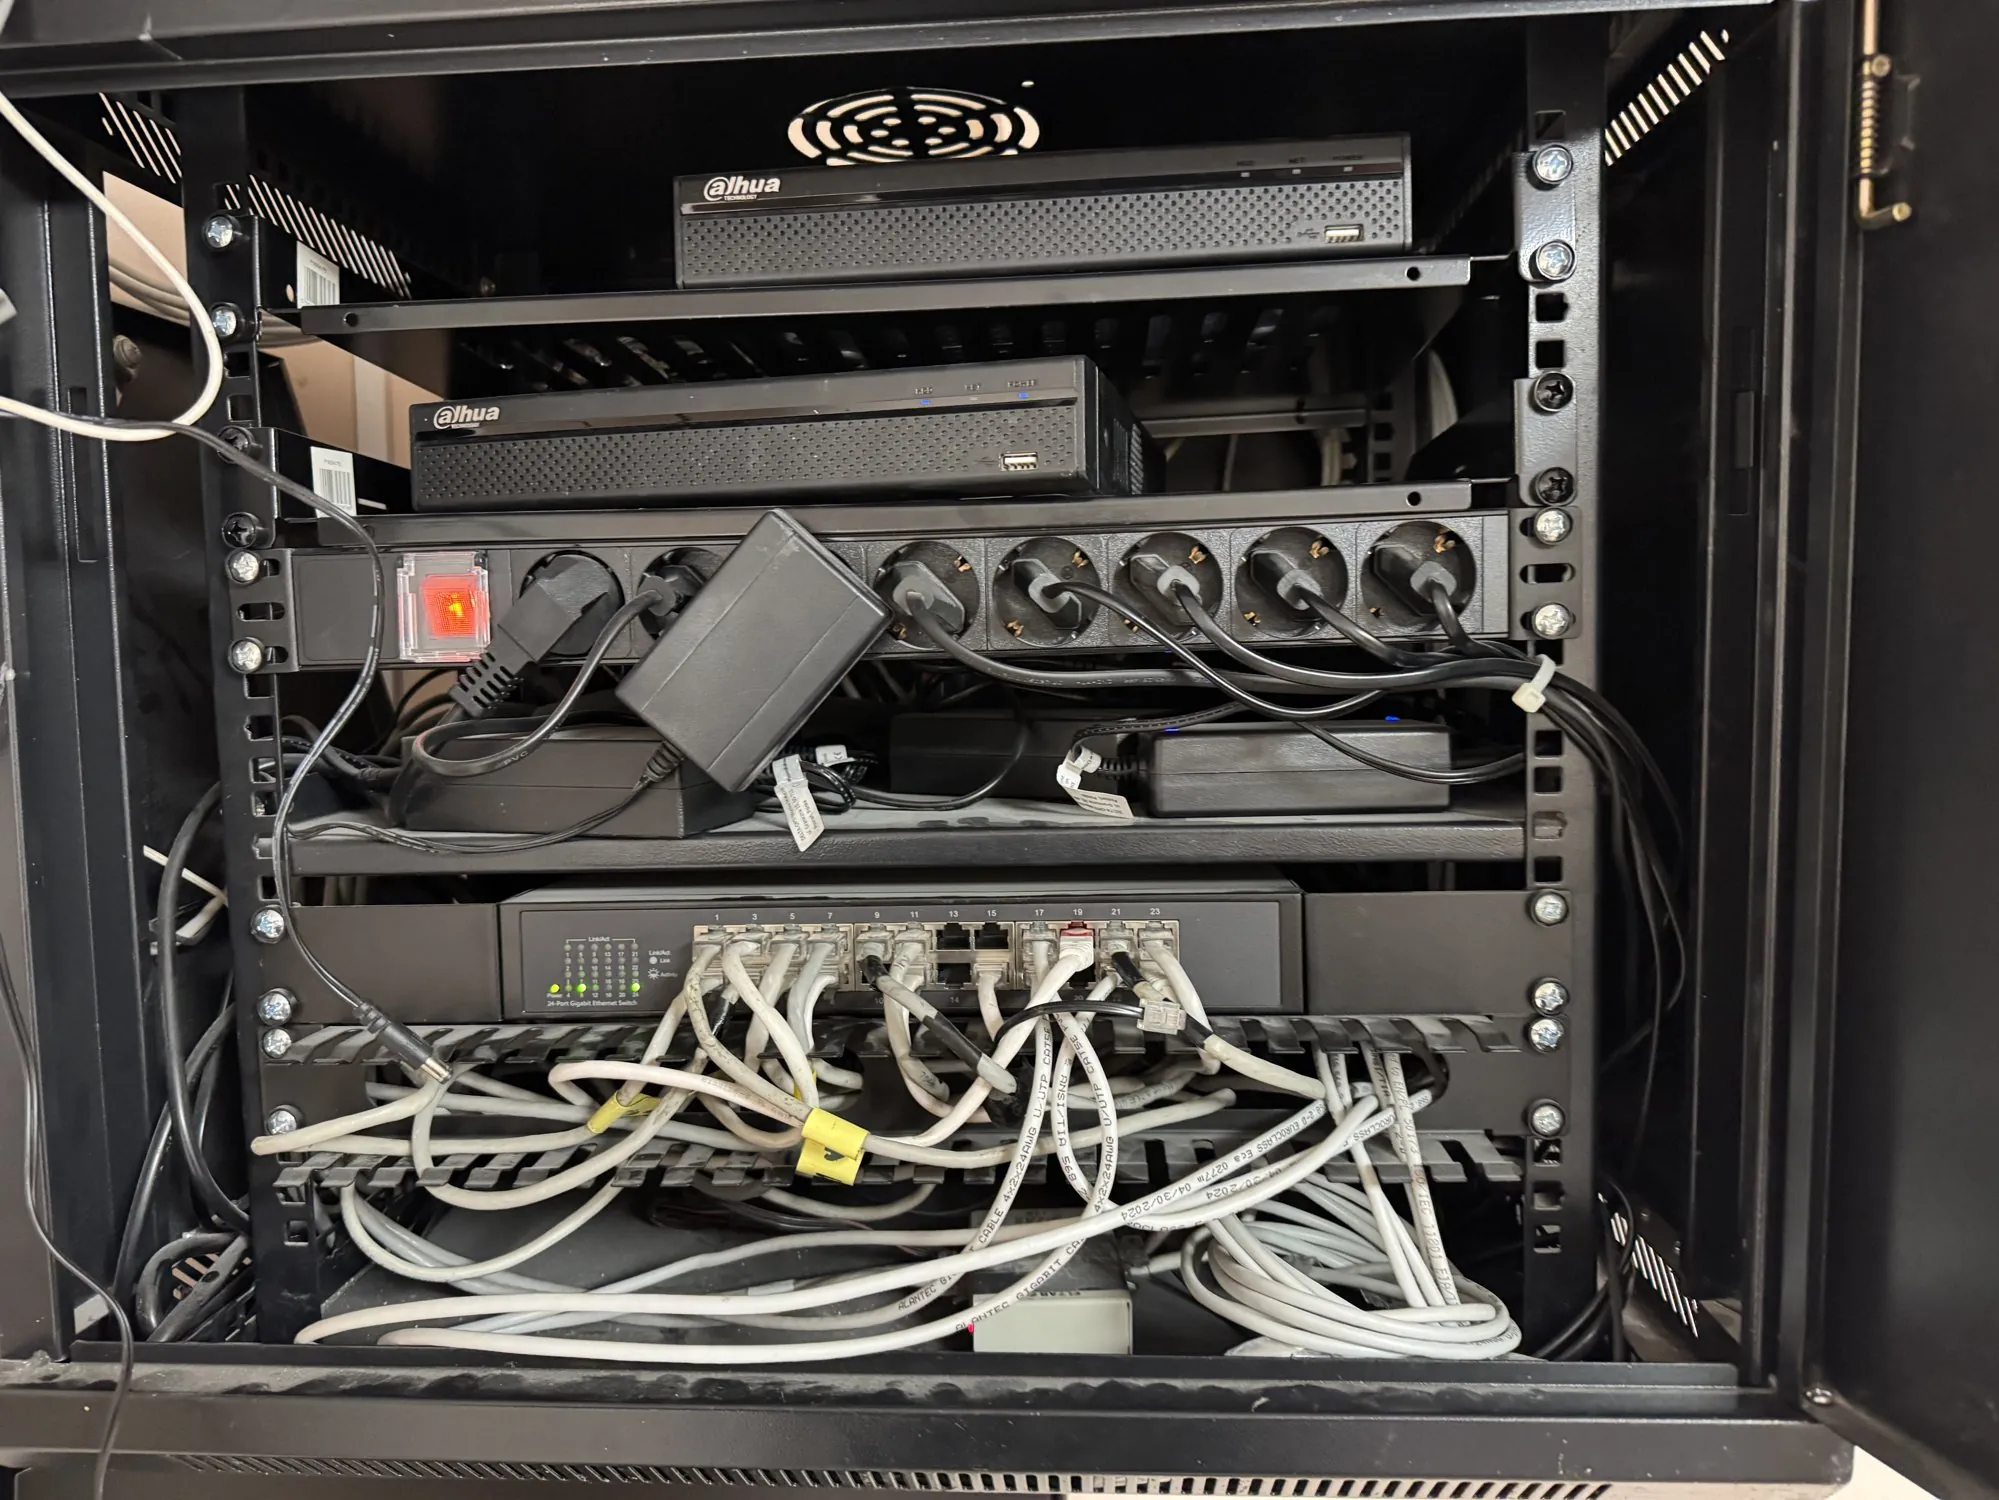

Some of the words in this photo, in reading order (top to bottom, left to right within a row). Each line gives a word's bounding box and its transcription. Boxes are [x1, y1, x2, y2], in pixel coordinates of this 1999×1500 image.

[752, 913, 758, 921] 3
[790, 912, 796, 920] 5
[827, 912, 833, 920] 7
[874, 911, 880, 919] 9
[949, 910, 959, 918] 13
[987, 909, 997, 917] 15
[1035, 909, 1044, 917] 17
[1073, 908, 1083, 916] 19
[1111, 908, 1121, 916] 21
[1150, 907, 1160, 916] 23
[1069, 1034, 1095, 1074] CAT5E
[1056, 1074, 1068, 1147] ANSI/TIA
[1093, 1083, 1113, 1127] U/UTP
[1257, 1120, 1299, 1153] EUROCLASS
[979, 1208, 1004, 1243] CABLE
[1003, 1127, 1037, 1202] 4x2x24AWG
[1033, 1074, 1049, 1119] U/UTP
[1233, 1148, 1253, 1162] Eca
[1093, 1135, 1115, 1213] 4x2x24AWG
[1121, 1183, 1191, 1220] 04/30/2024
[898, 1285, 936, 1311] ALANTEC
[955, 1301, 1010, 1331] ALANTEC
[1016, 1259, 1062, 1301] GIGABIT
